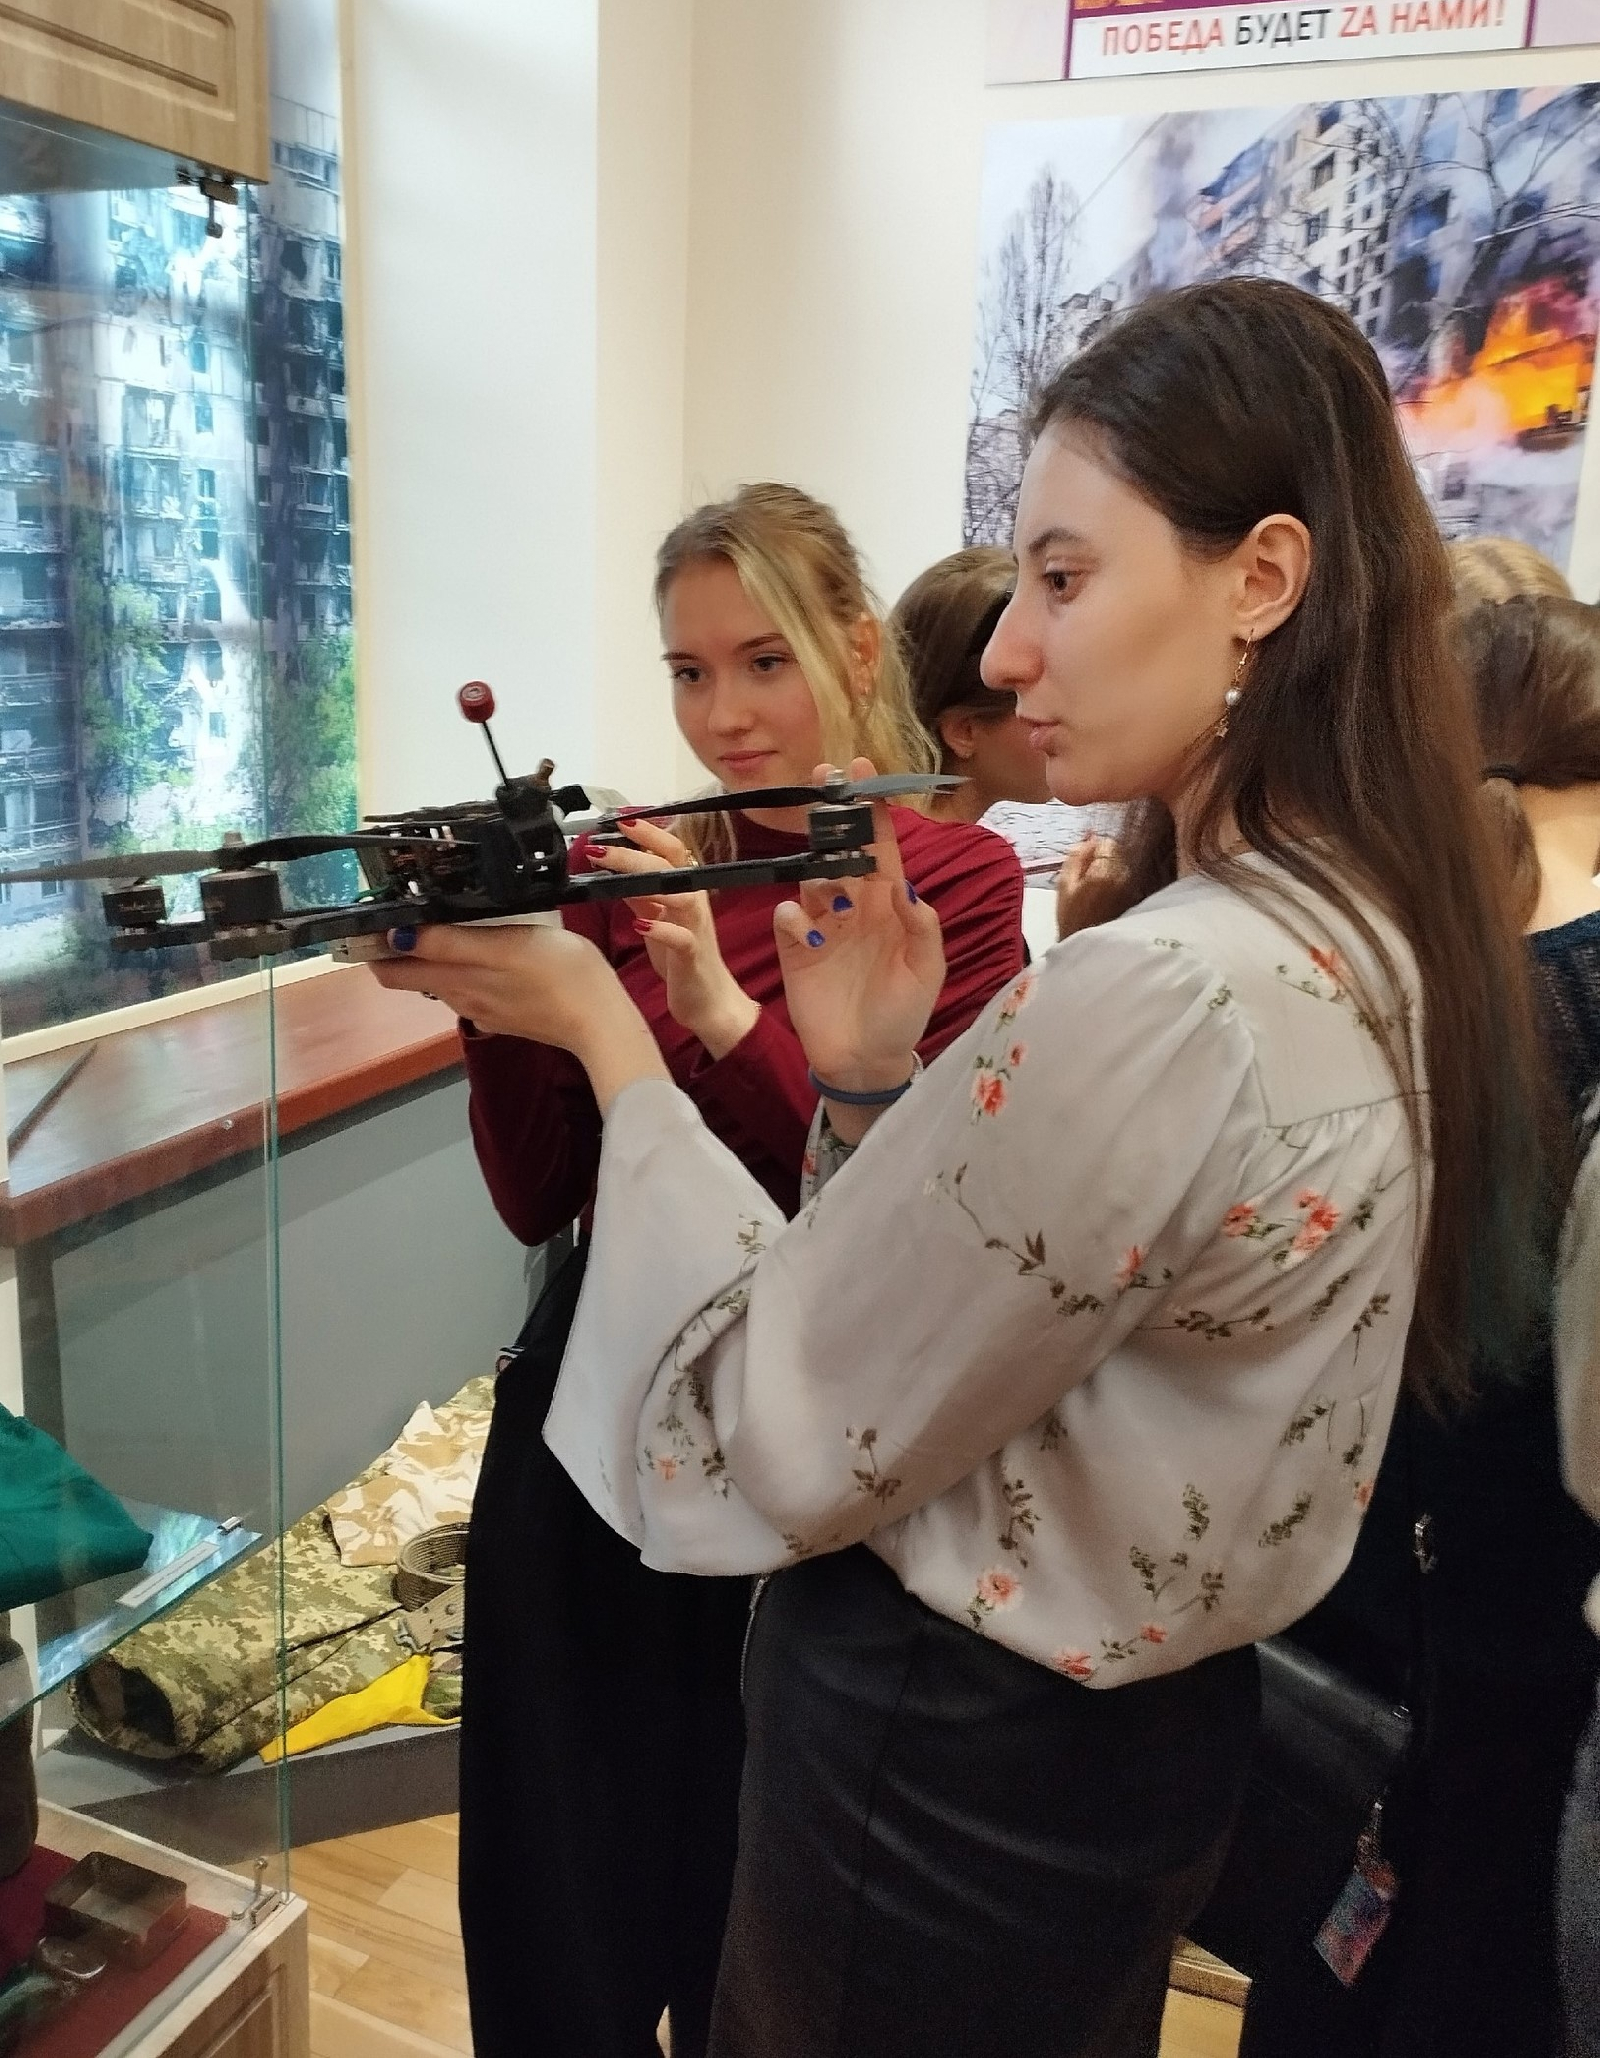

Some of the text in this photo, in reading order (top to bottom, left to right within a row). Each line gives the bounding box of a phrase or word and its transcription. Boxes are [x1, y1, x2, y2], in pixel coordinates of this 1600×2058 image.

[1102, 18, 1224, 56] ПОБЕДА
[1235, 8, 1333, 48] БУДЕТ
[1390, 0, 1506, 34] НАМИ!
